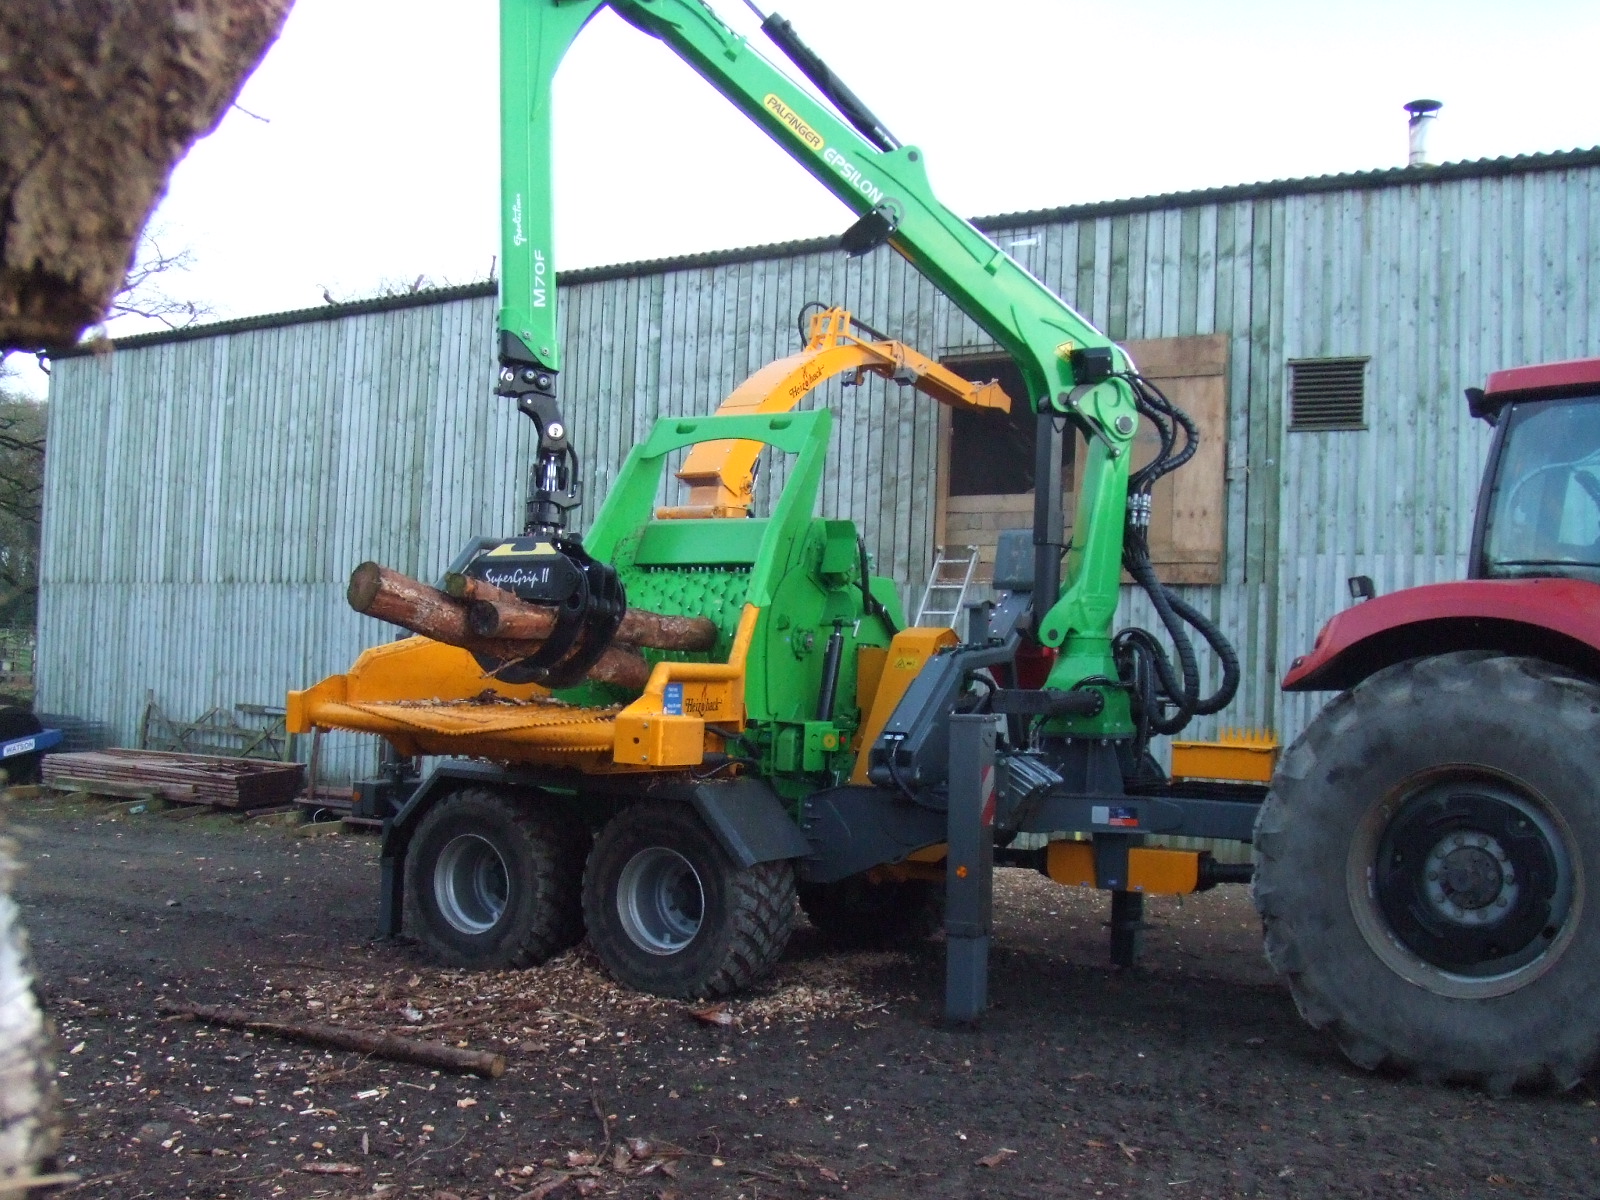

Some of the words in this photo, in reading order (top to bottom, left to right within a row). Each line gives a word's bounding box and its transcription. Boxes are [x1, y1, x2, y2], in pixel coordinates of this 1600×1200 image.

[766, 96, 821, 148] PALFINGER
[823, 147, 884, 204] EPSILON
[533, 249, 546, 308] M70F
[485, 568, 539, 589] SuperGrip
[6, 740, 34, 754] WATSON
